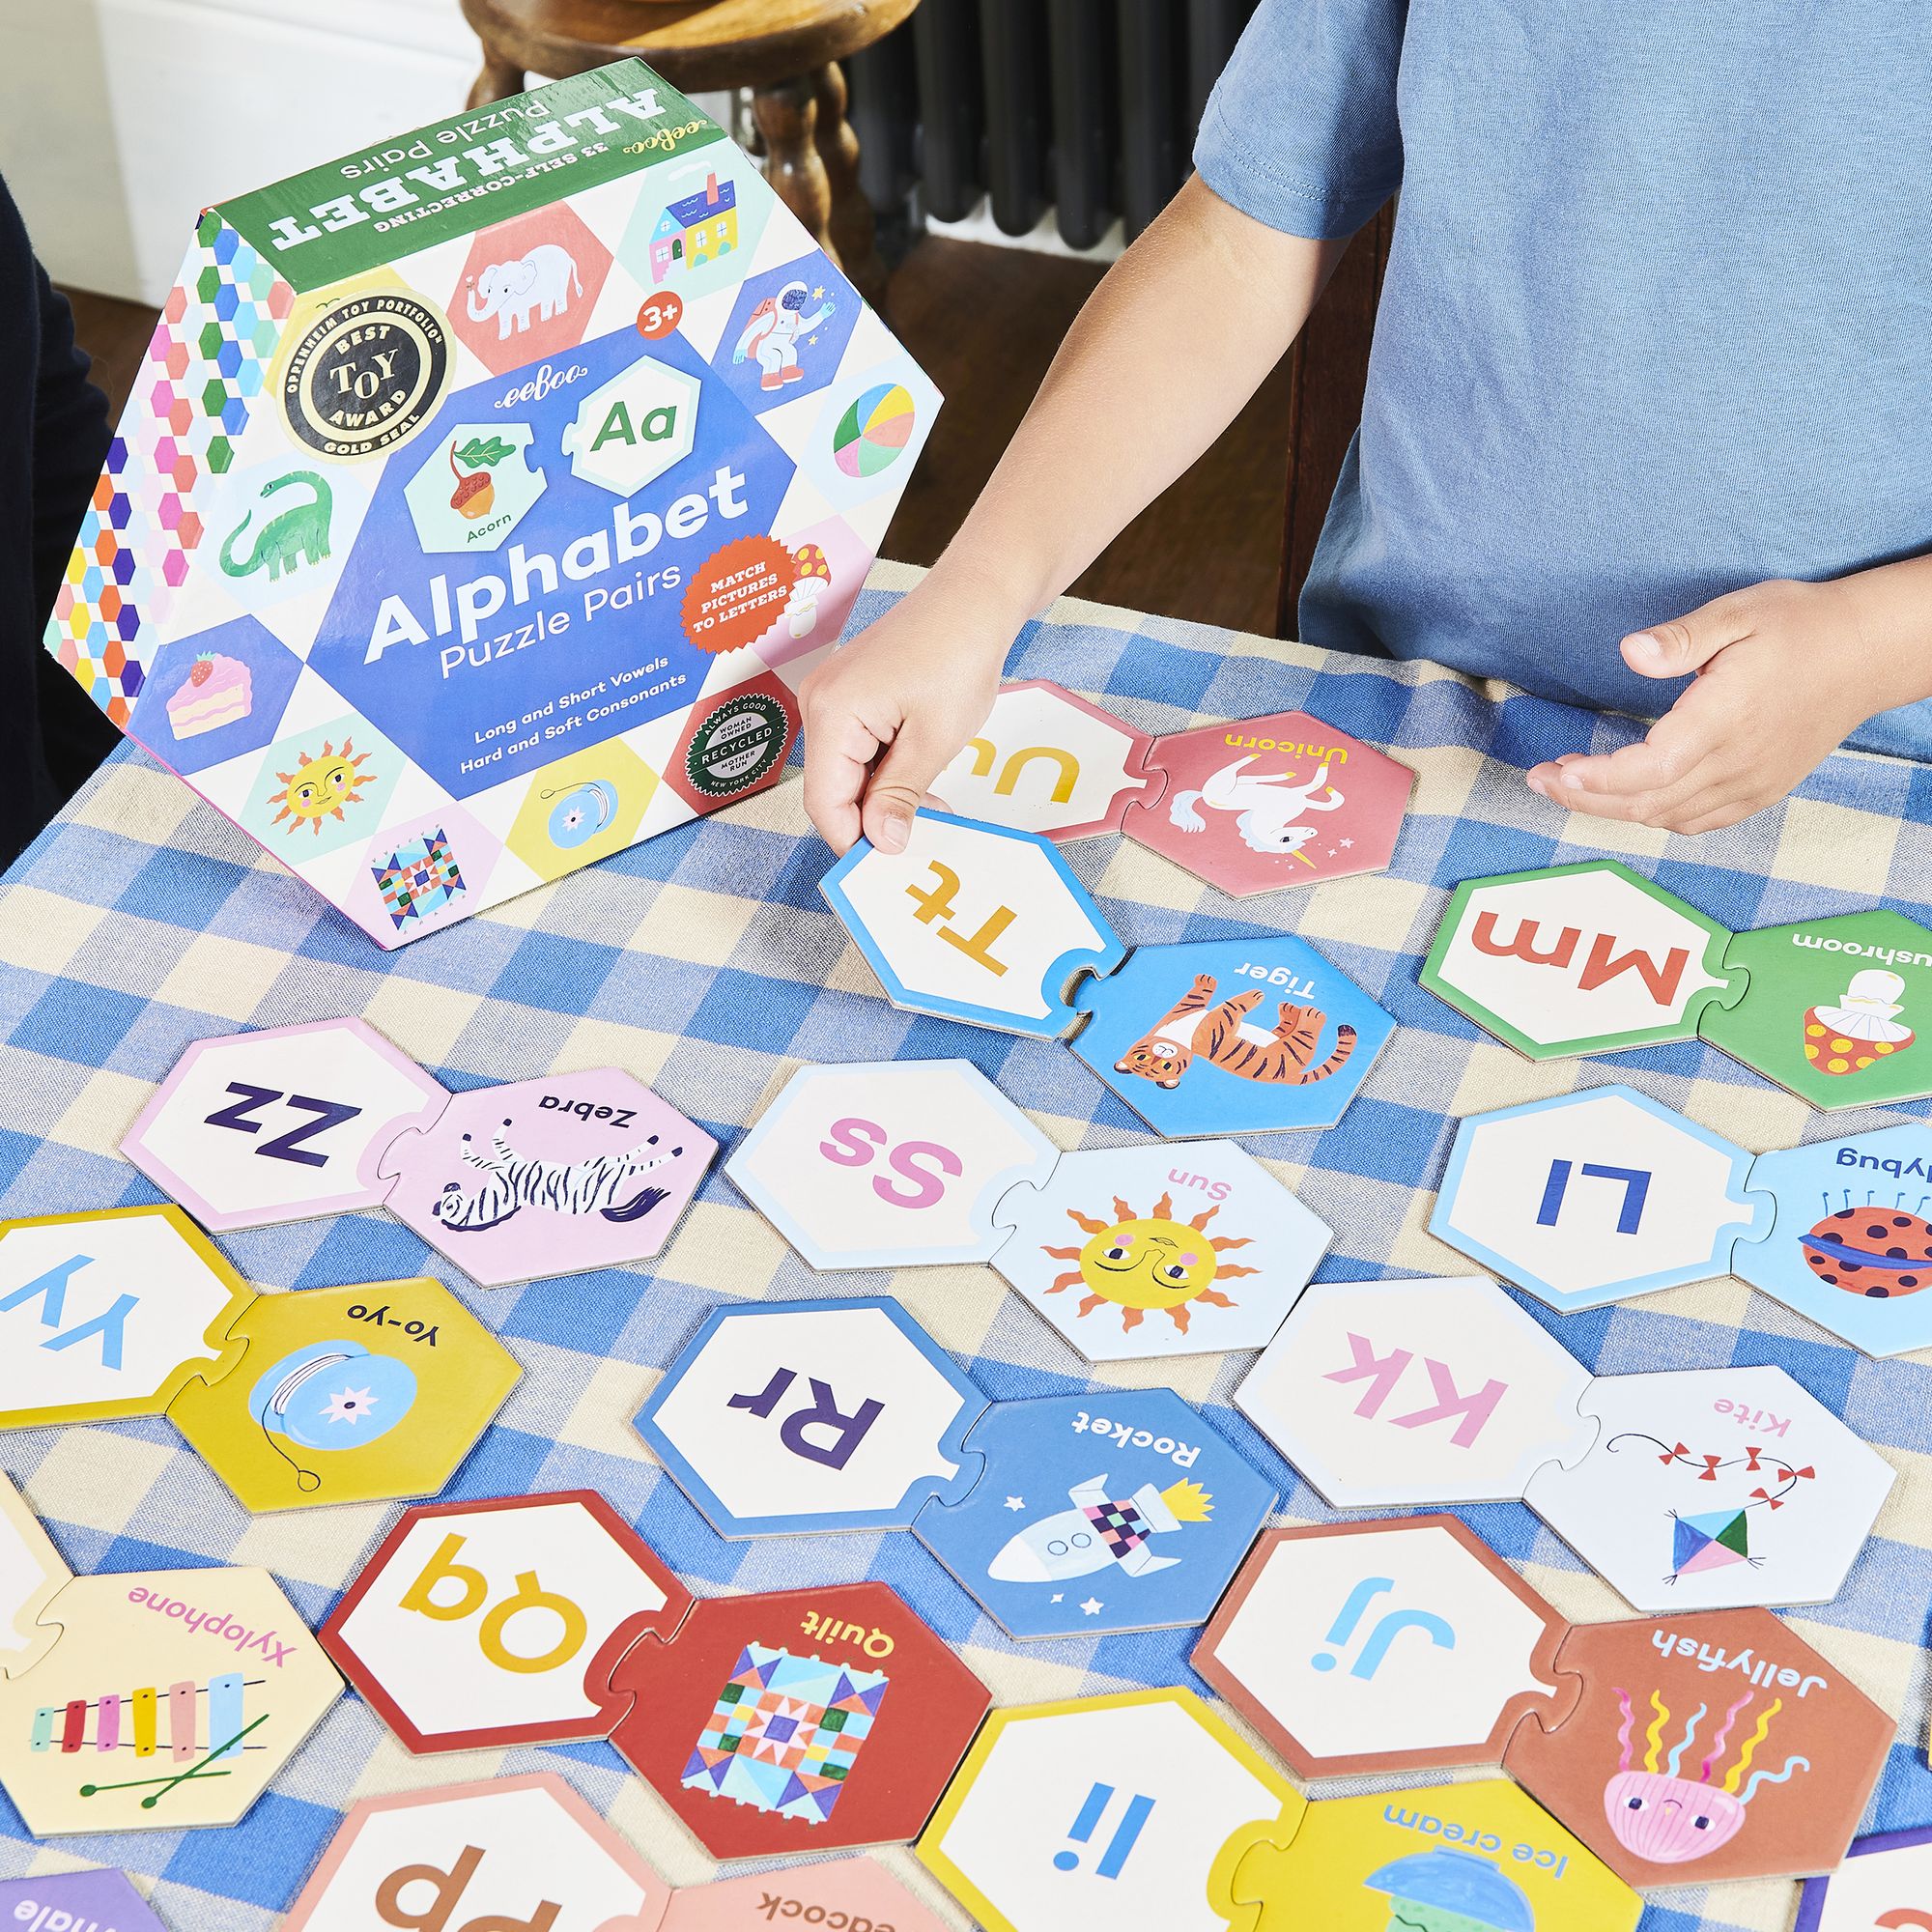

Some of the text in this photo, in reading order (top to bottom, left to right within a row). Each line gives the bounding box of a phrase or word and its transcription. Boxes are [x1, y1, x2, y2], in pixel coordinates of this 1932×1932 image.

[340, 99, 551, 179] Puzzle Pairs
[268, 88, 667, 251] ALPHABET
[373, 142, 610, 232] 33 SELF-CORRECTING
[335, 326, 391, 355] BEST
[642, 303, 678, 332] 3+
[287, 317, 338, 393] OPPENHEIM
[341, 300, 370, 319] TOY
[329, 349, 399, 399] TOY
[324, 413, 420, 454] GOLD SEAL
[328, 389, 407, 427] AWARD
[589, 401, 677, 452] Aa
[466, 512, 512, 544] Acorn
[363, 465, 749, 665] Alphabet
[710, 561, 766, 593] MATCH
[693, 585, 787, 633] TO LETTERS
[701, 573, 779, 614] PICTURES
[439, 564, 681, 679] Puzzle Pairs
[460, 673, 688, 775] Hard and Soft Consonants
[474, 656, 669, 744] Long and Short Vowels
[704, 702, 767, 735] ALWAYS GOOD
[719, 716, 752, 734] WOMAN
[700, 727, 772, 764] RECYCLED
[721, 723, 752, 740] OWNED
[1225, 733, 1349, 764] Unicorn
[710, 758, 767, 788] NEW YORK CITY
[721, 751, 755, 769] MOTHER
[729, 760, 748, 772] RUN
[904, 860, 1017, 977] Tt
[1234, 962, 1316, 1000] Tiger
[1470, 911, 1690, 1007] Mm
[203, 1081, 363, 1168] Zz
[538, 1095, 638, 1129] Zebra
[819, 1117, 963, 1209] Ss
[1167, 1167, 1233, 1202] Sun
[0, 1254, 141, 1371] Yy
[347, 1304, 440, 1348] Yo-yo
[1321, 1331, 1509, 1449] Kk
[726, 1367, 885, 1471] Rr
[1070, 1411, 1203, 1469] Rocket
[1713, 1398, 1793, 1437] Kite
[128, 1586, 298, 1668] Xylophone
[398, 1532, 587, 1674] Qq
[800, 1609, 895, 1660] Quilt
[1311, 1577, 1456, 1681] Jj
[1652, 1629, 1828, 1698] Jellyfish
[1383, 1804, 1569, 1880] Ice cream
